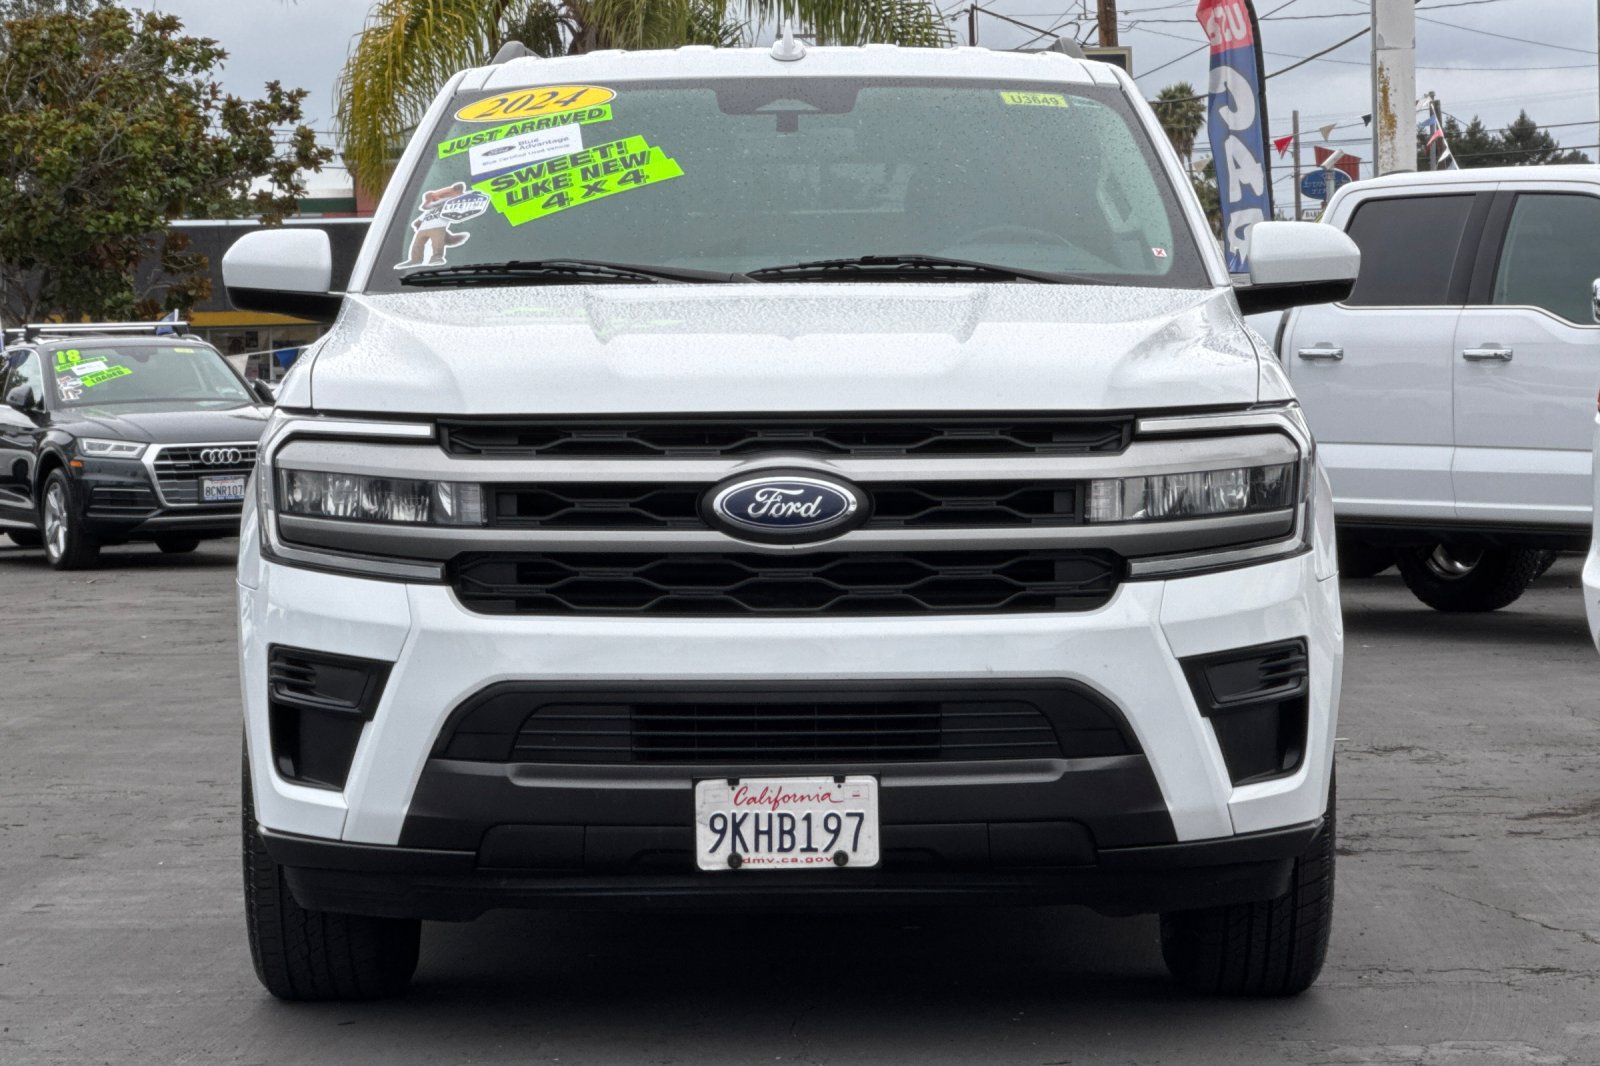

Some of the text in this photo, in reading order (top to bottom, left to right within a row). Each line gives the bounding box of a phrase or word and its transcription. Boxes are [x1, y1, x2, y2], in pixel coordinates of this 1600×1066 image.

[473, 88, 590, 119] 2024
[442, 108, 607, 153] JUST ARRIVED
[518, 137, 539, 146] Blue
[519, 136, 569, 151] Advantage
[490, 141, 629, 193] SWEET!
[506, 150, 650, 207] LIKE NEW
[541, 191, 574, 210] 4
[617, 169, 650, 187] 4
[57, 349, 81, 364] 18
[748, 487, 823, 518] Ford
[733, 785, 844, 811] California
[708, 812, 865, 854] 9KHB197
[742, 855, 834, 865] dmv.ca.gov
